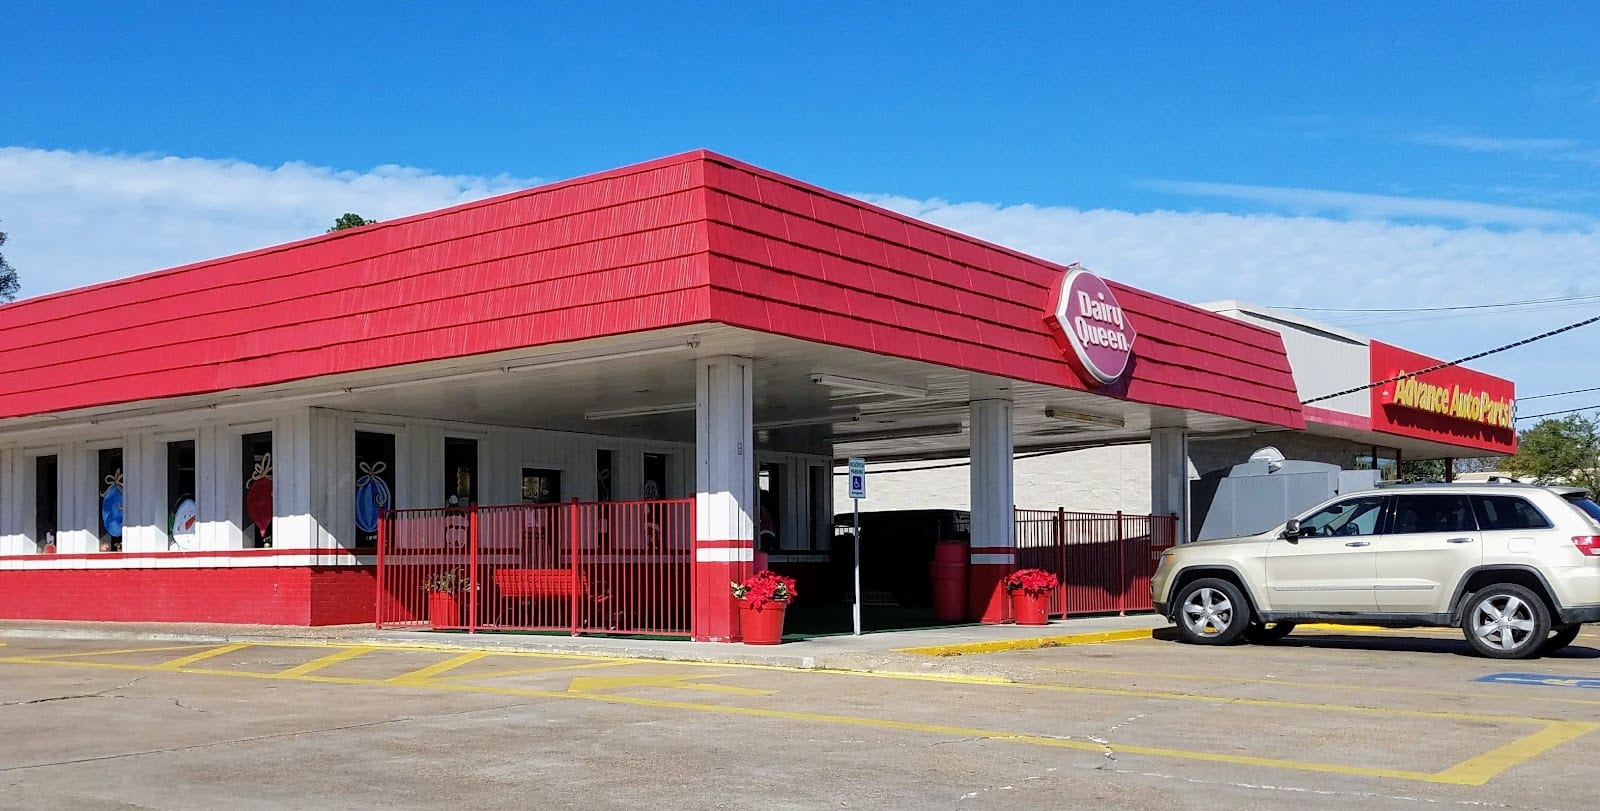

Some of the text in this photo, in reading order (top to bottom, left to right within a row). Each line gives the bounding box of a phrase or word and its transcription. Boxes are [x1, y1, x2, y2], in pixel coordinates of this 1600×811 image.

[1077, 290, 1124, 330] Dairy
[1075, 316, 1128, 351] Queen
[1394, 370, 1509, 428] Advance Auto Parts
